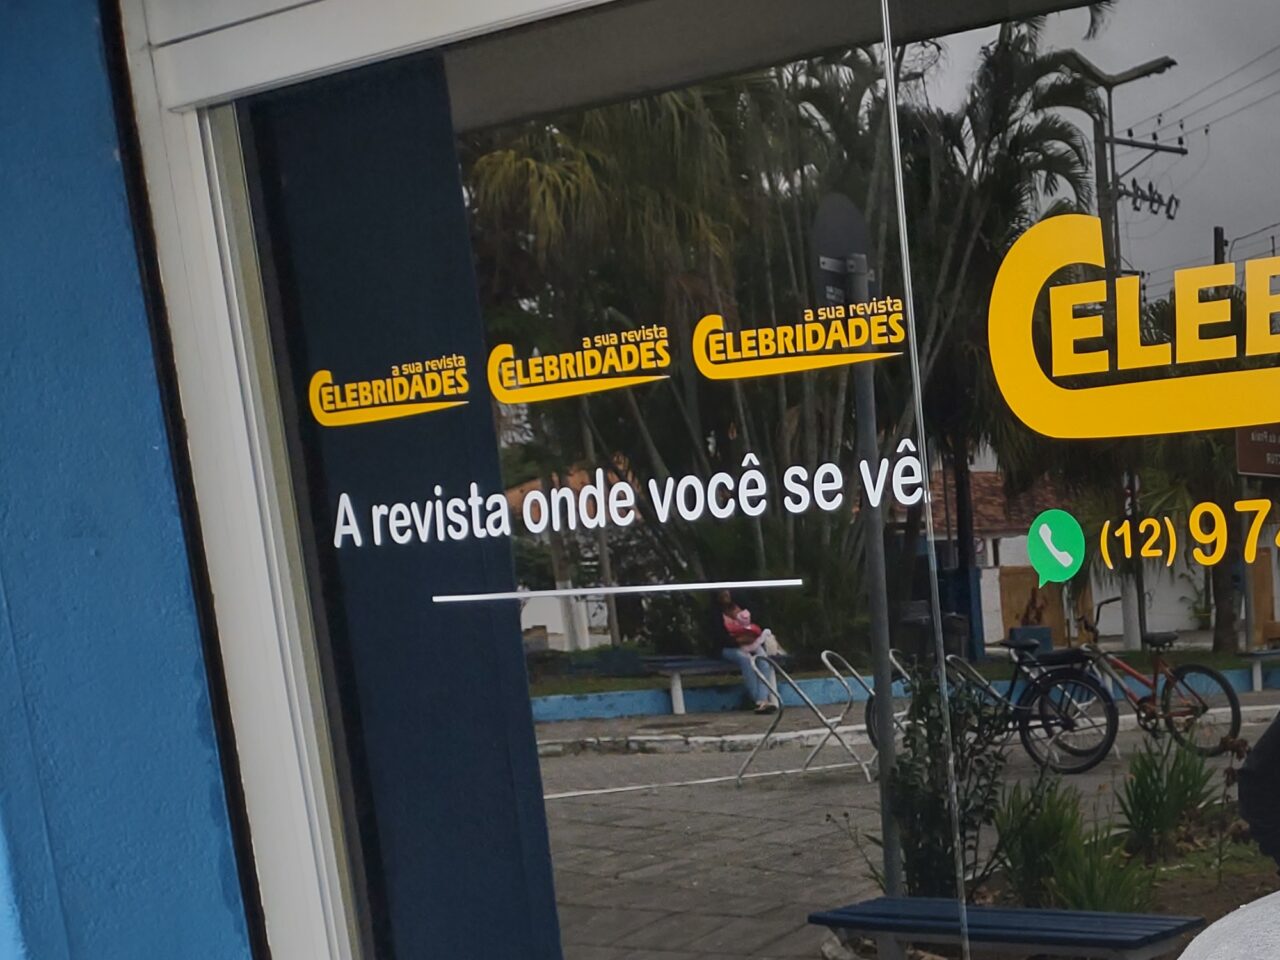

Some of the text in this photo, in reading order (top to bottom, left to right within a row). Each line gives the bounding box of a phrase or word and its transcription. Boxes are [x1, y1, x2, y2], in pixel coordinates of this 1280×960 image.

[582, 325, 668, 349] a sua revista
[803, 295, 903, 322] a sua revista
[391, 353, 466, 377] a sua revista
[487, 340, 672, 404] CELEBRIDADES
[692, 313, 906, 380] CELEBRIDADES
[309, 367, 470, 427] CELEBRIDADES
[333, 438, 923, 548] A revista onde você se vê
[1100, 516, 1177, 570] (12)
